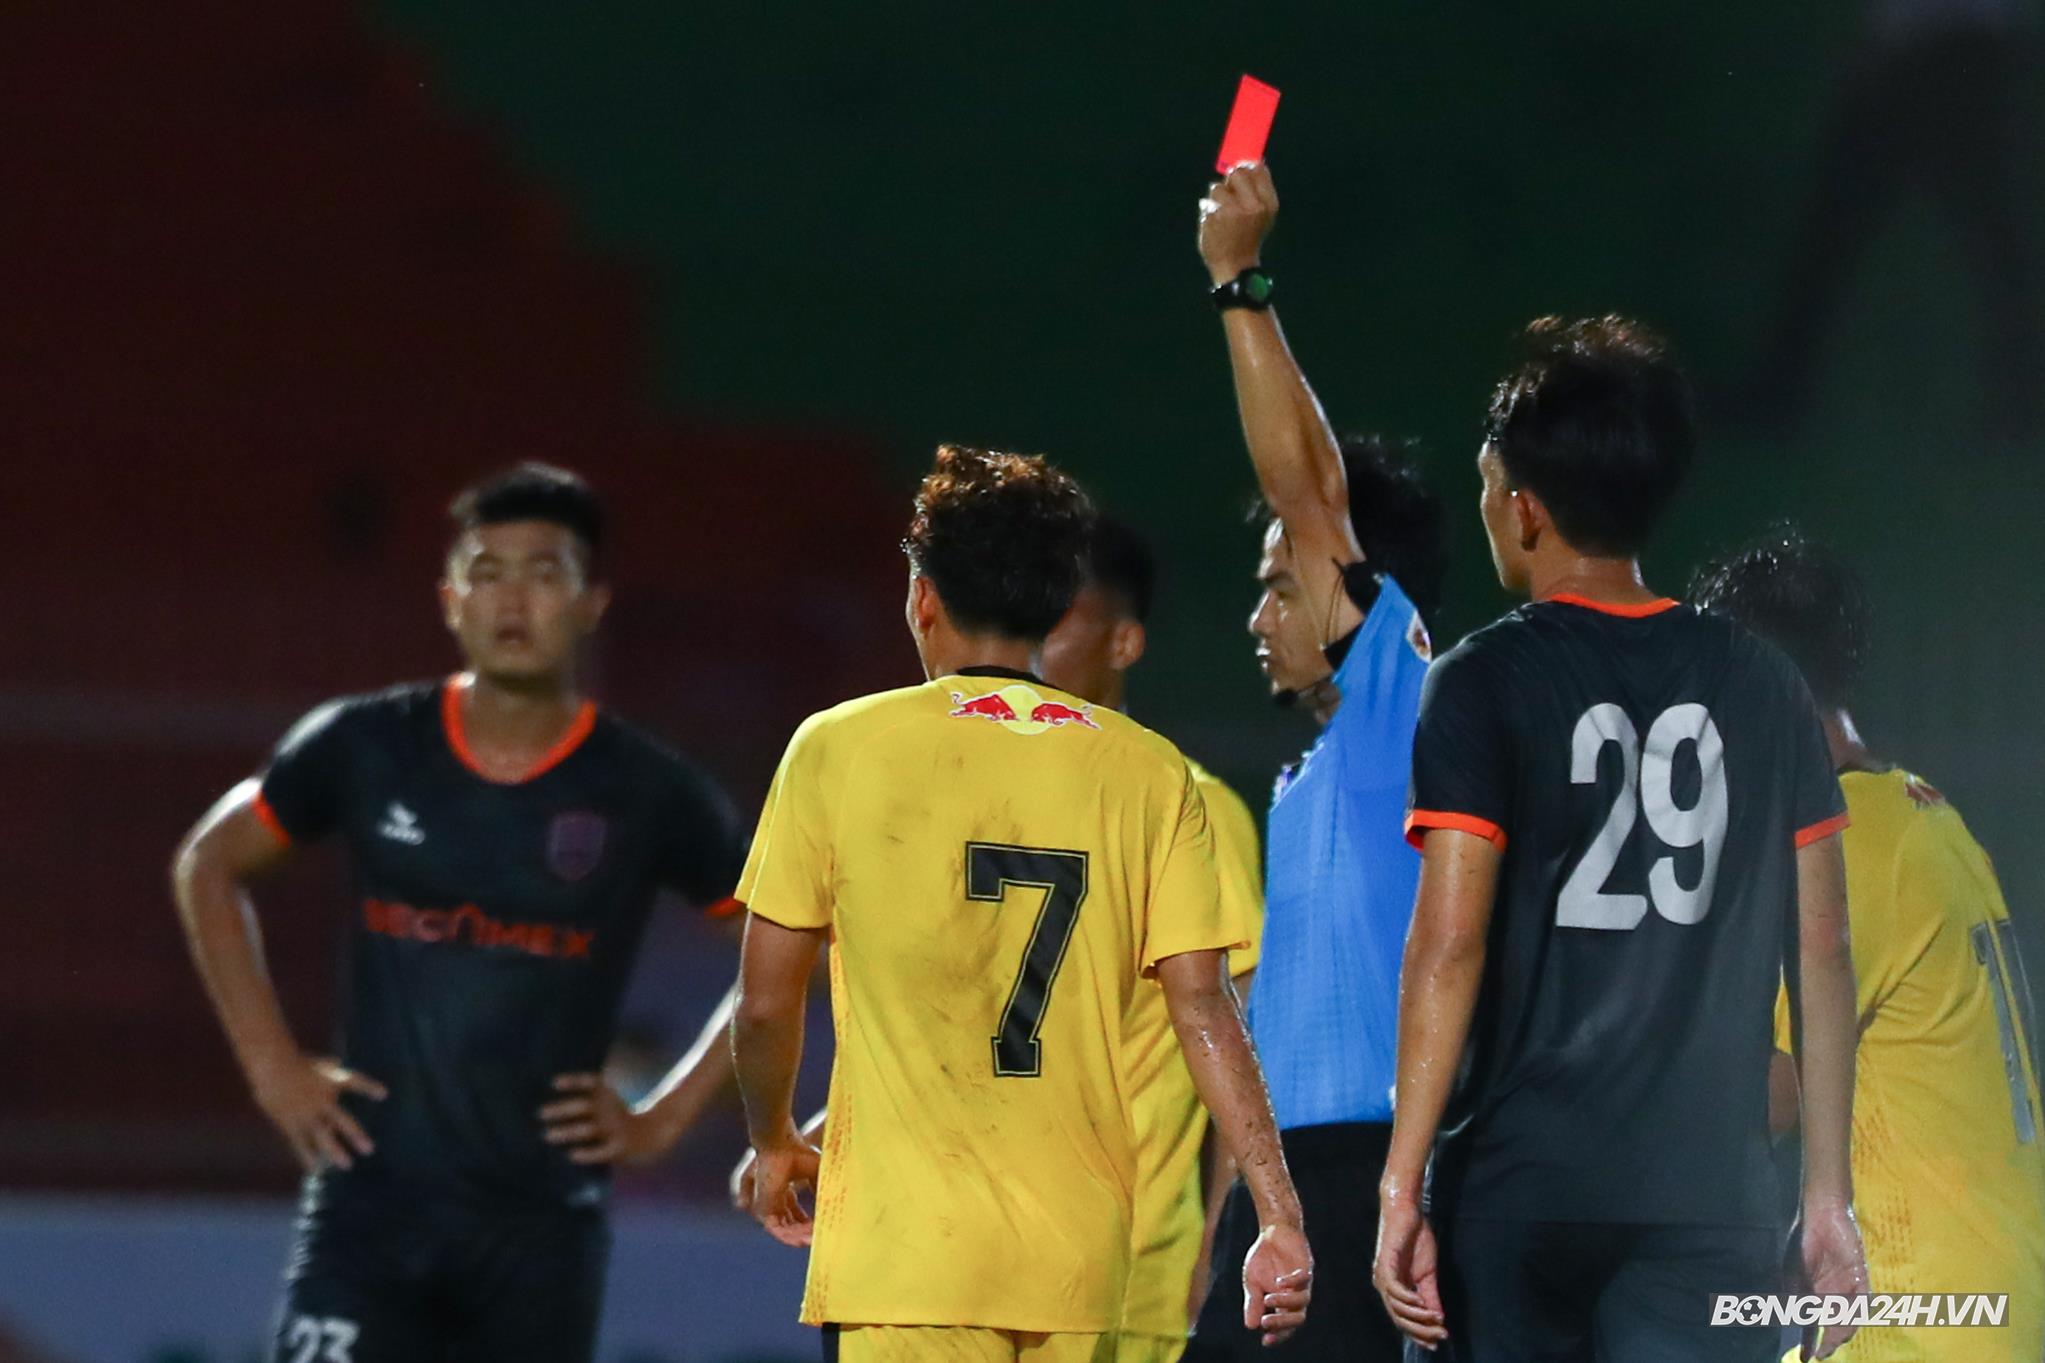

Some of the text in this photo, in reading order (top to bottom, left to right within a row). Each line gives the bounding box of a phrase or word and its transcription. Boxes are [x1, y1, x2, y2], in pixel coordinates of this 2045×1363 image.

[1555, 702, 1729, 930] 29
[965, 841, 1089, 1078] 7
[286, 1315, 361, 1363] 23
